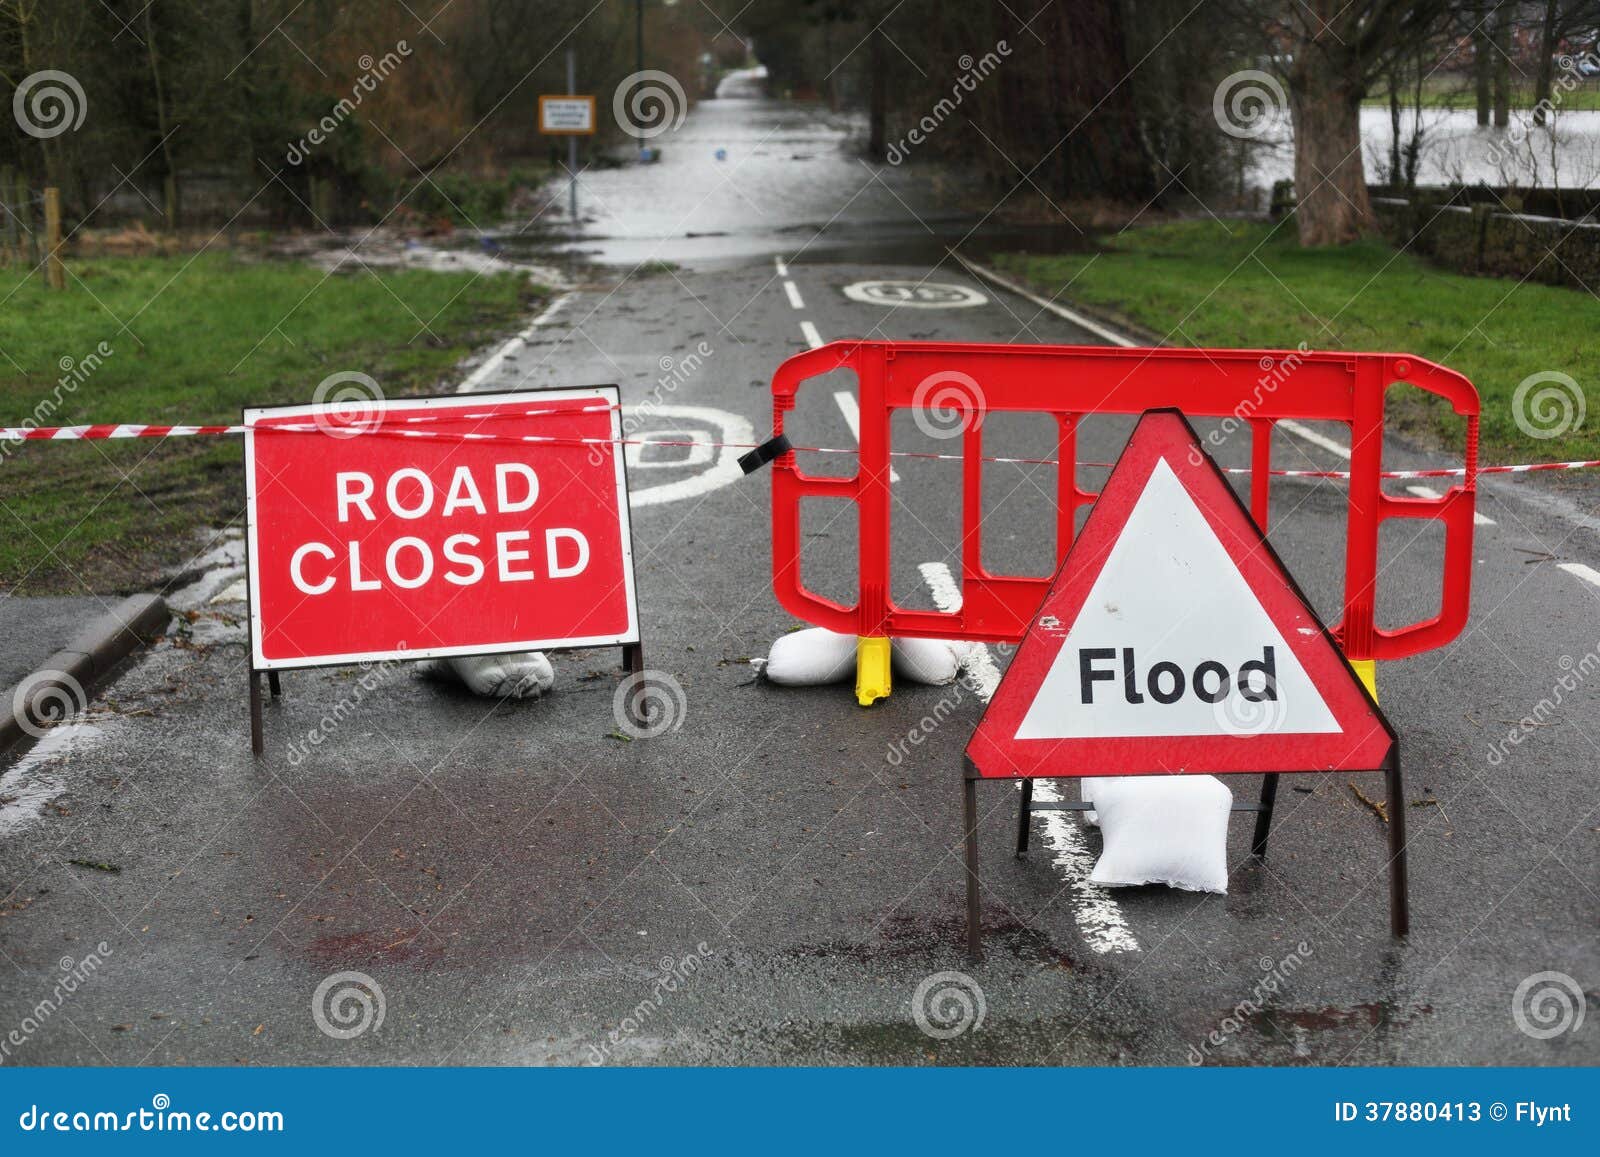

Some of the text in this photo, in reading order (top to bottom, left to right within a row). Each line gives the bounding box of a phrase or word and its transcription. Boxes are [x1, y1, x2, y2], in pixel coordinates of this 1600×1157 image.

[336, 462, 540, 523] ROAD
[290, 527, 590, 595] CLOSED
[1079, 646, 1278, 704] Flood
